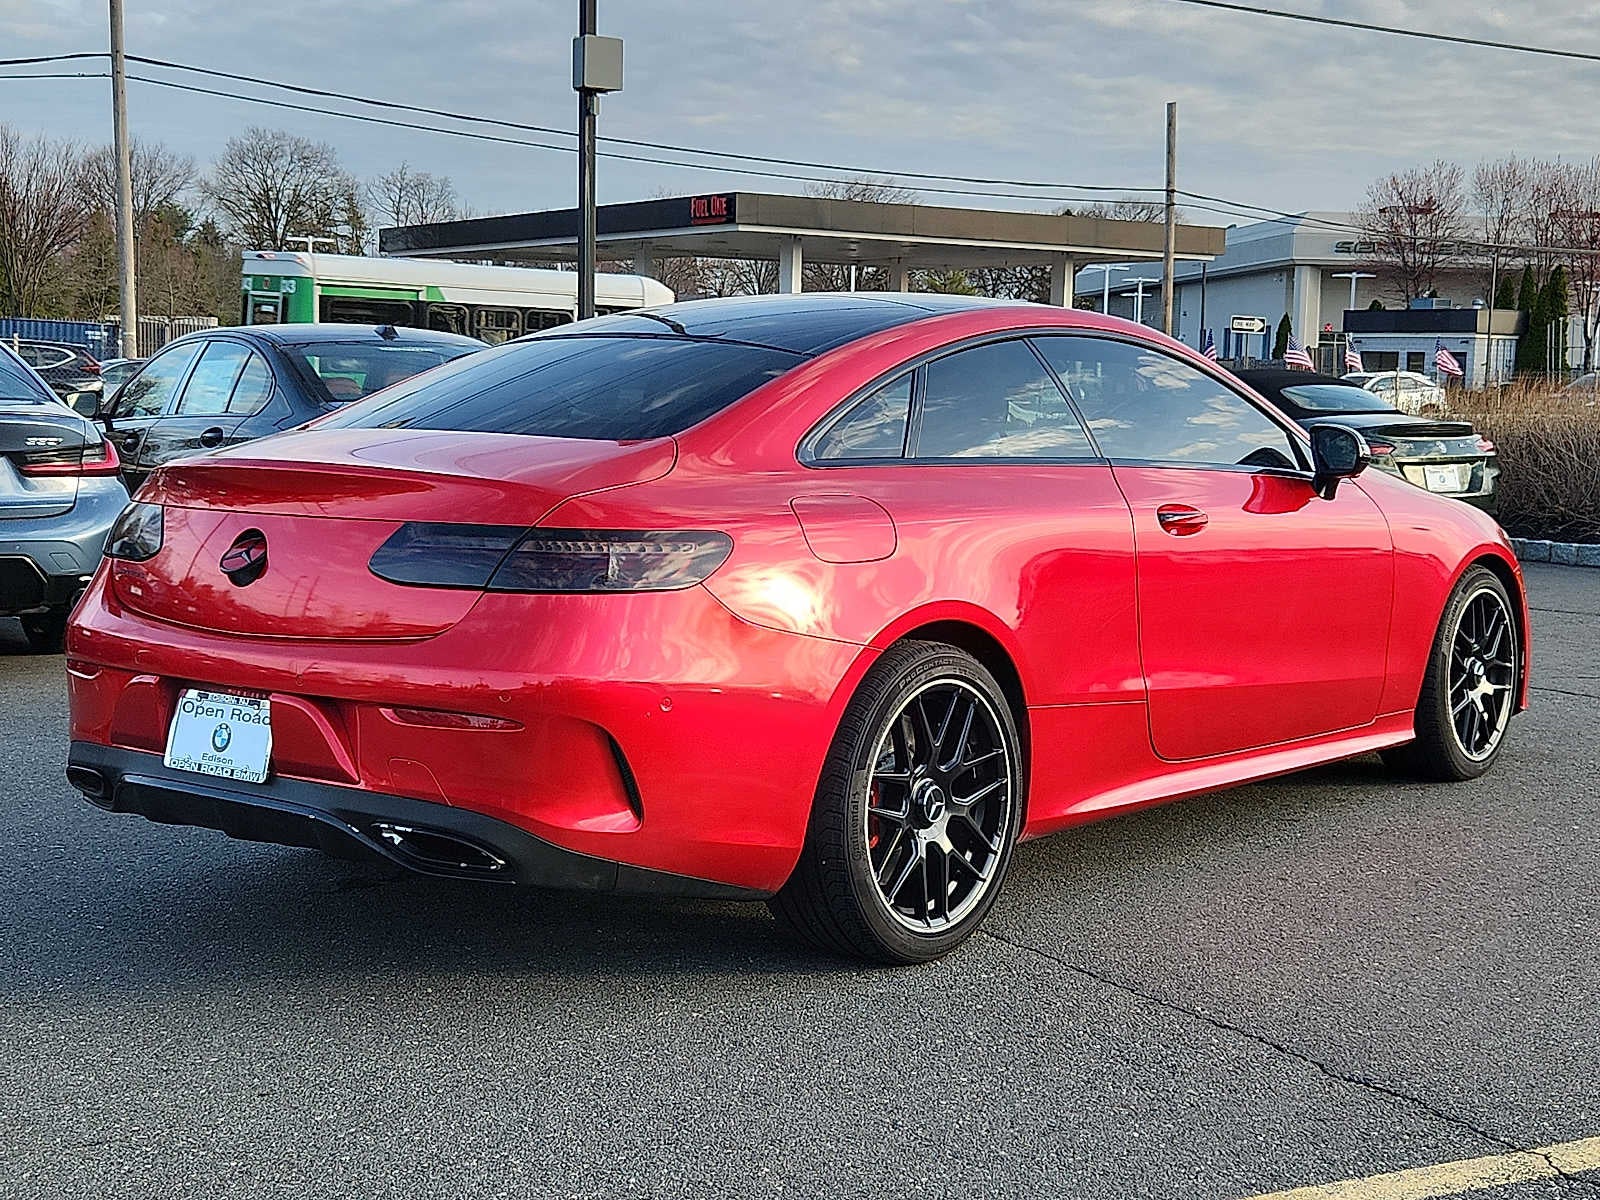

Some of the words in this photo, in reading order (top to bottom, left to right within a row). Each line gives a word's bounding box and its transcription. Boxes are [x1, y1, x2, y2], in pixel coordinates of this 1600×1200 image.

[691, 197, 709, 217] FUEL
[711, 195, 727, 216] ONE
[182, 700, 225, 719] Open
[201, 752, 234, 766] Edison
[170, 758, 199, 770] OPEN
[201, 764, 232, 777] ROAD
[233, 769, 261, 782] BMW
